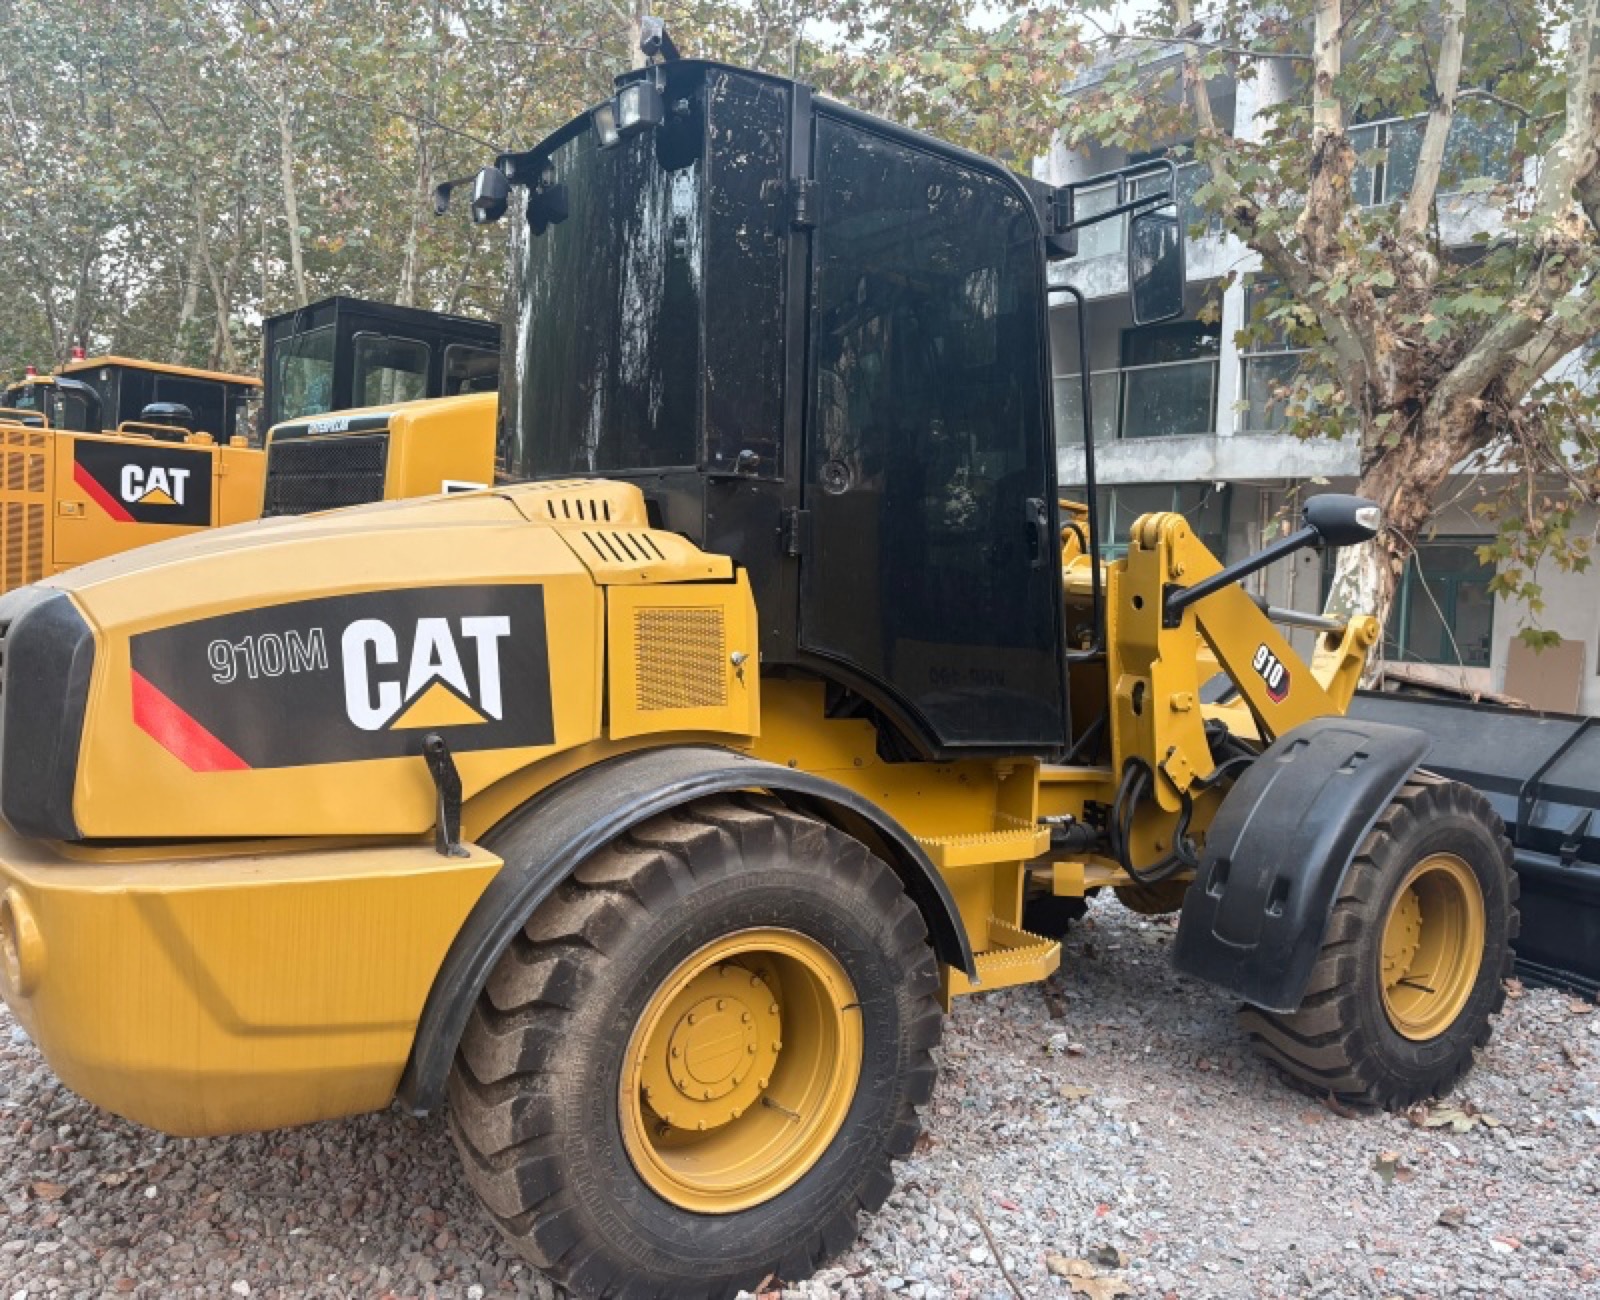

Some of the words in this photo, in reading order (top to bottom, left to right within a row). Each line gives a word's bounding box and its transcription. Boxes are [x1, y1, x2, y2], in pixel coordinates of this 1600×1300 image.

[120, 464, 191, 505] CAT
[207, 628, 329, 684] 910M
[342, 616, 511, 730] CAT
[1253, 645, 1284, 688] 910
